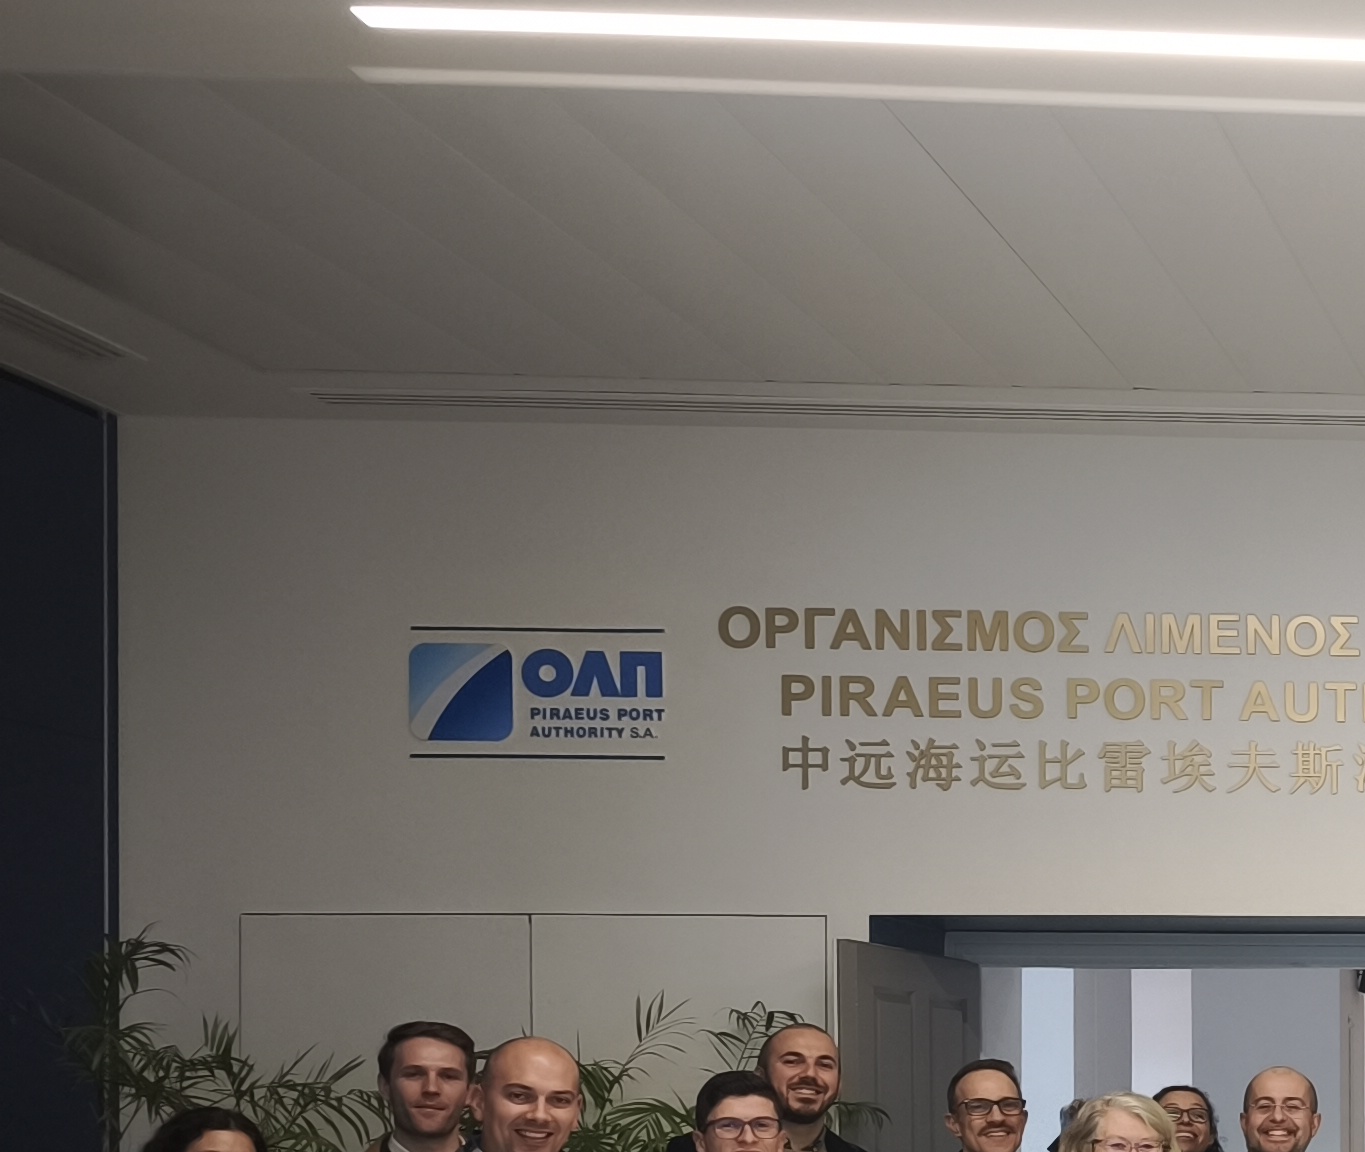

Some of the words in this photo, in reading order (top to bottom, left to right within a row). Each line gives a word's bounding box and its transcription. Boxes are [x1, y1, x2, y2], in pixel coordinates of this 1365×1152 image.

[716, 604, 1090, 655] ΟΡΓΑΝΙΣΜΟΣ
[1104, 613, 1361, 657] ΛΙΜΕΝΟΣ
[780, 673, 1045, 719] PIRAEUS
[1066, 677, 1224, 722] PORT
[529, 707, 610, 722] PIRAEUS
[616, 708, 665, 722] PORT
[529, 725, 625, 739] AUTHORITY
[629, 727, 658, 740] S.A.
